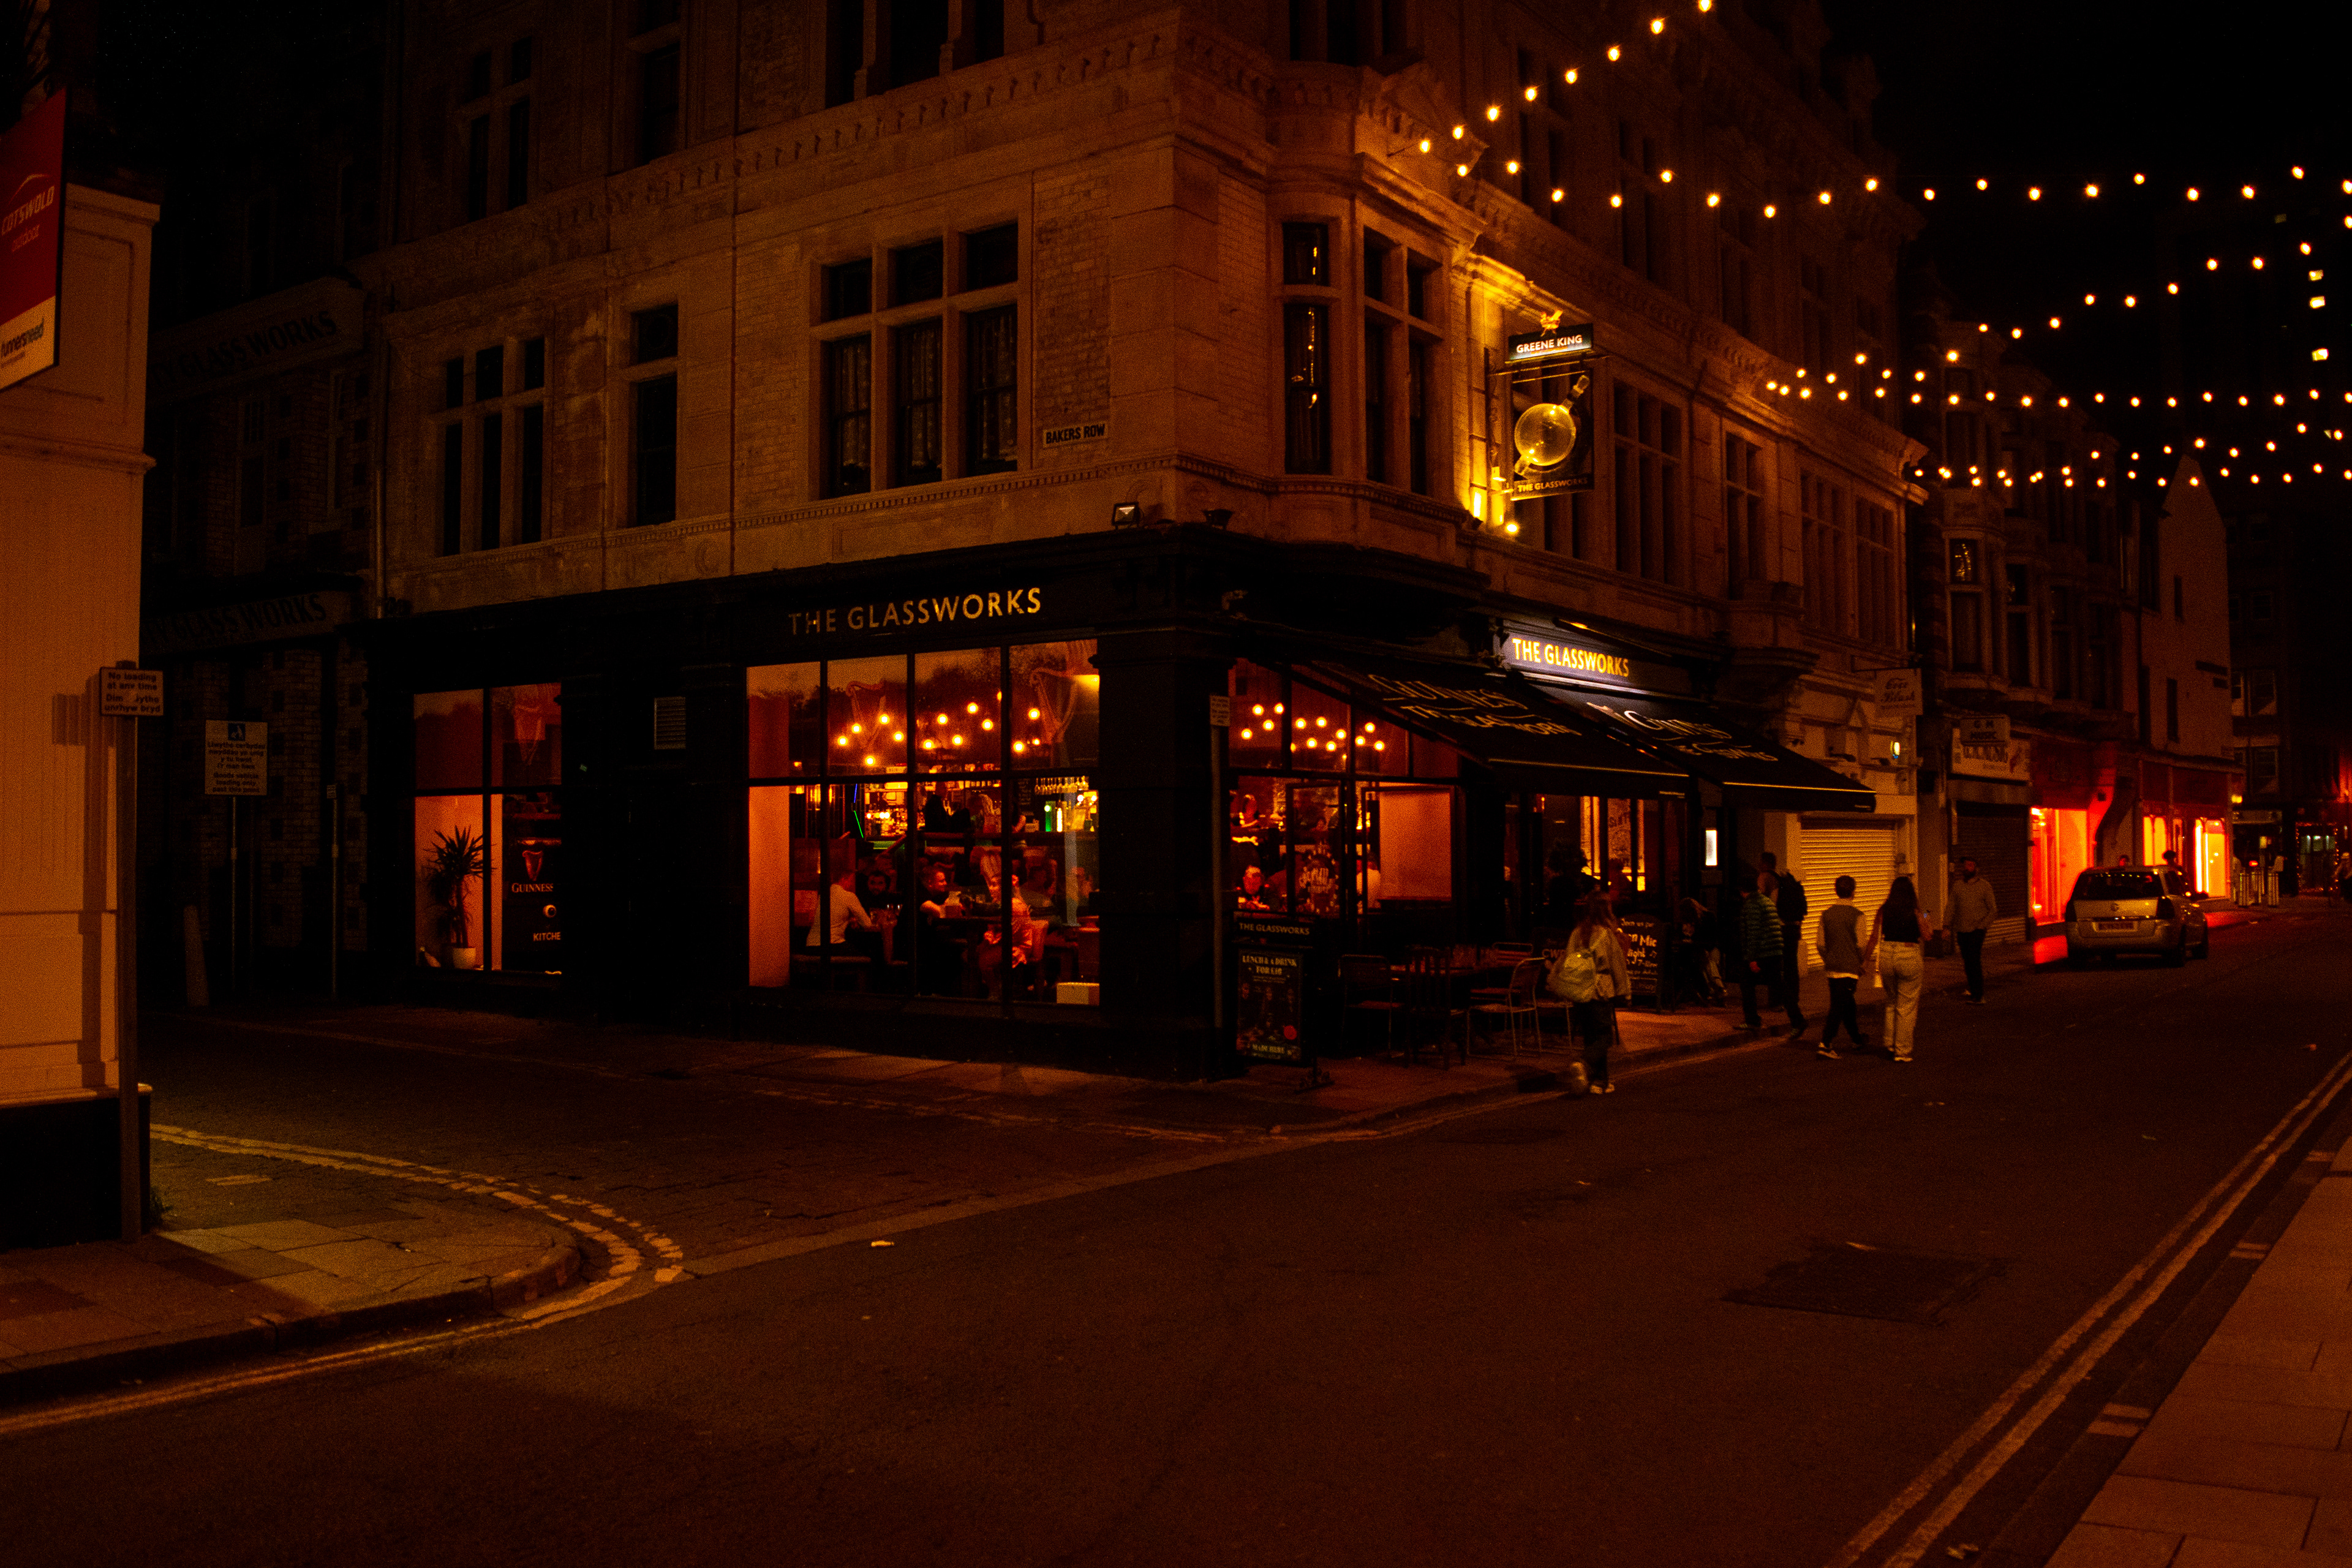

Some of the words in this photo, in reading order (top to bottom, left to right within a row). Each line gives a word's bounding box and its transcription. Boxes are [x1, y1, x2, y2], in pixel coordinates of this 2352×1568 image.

[2, 184, 55, 236] COTSWOLD
[178, 337, 247, 378] GLASS
[245, 310, 336, 357] WORKS
[1517, 339, 1555, 353] GREENE
[1557, 334, 1583, 347] KING
[1046, 427, 1080, 444] BAKERS
[1084, 424, 1105, 438] ROW
[1518, 483, 1533, 492] THE
[1534, 478, 1588, 490] GLASSWORKS
[238, 593, 326, 631] WORKS
[788, 608, 837, 635] THE
[848, 587, 1041, 630] GLASSWORKS
[1512, 638, 1542, 663] THE
[1544, 644, 1629, 677] GLASSWORKS
[124, 673, 156, 682] loading
[106, 693, 123, 702] Dim
[140, 705, 160, 714] bryd
[1238, 922, 1254, 931] THE
[1256, 924, 1310, 935] GLASSWORKS
[1640, 934, 1657, 947] Mic
